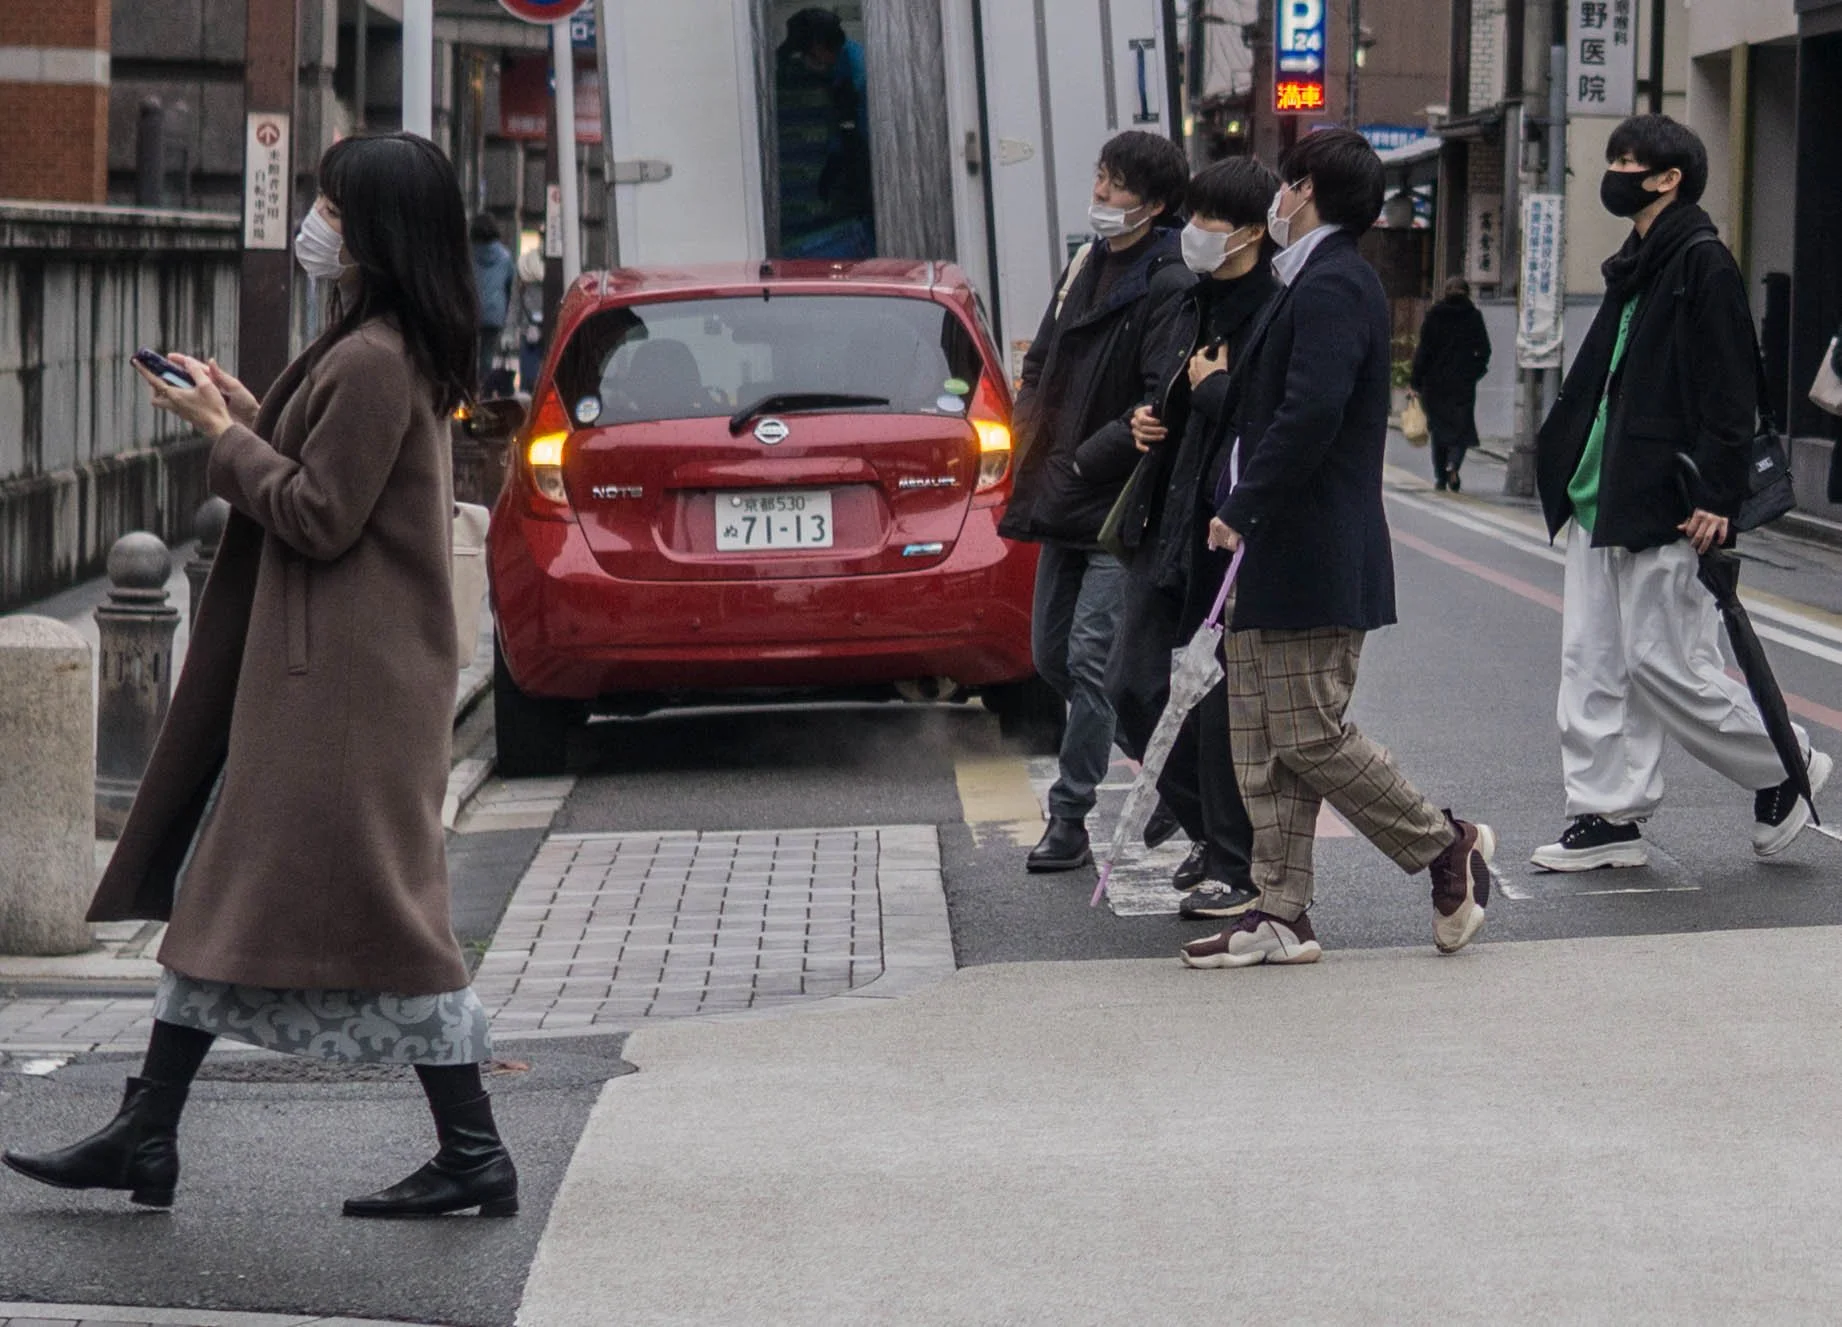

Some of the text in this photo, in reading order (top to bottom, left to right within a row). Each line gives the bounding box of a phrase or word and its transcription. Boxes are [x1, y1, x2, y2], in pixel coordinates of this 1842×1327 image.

[1579, 2, 1607, 102] 野医院
[1277, 82, 1324, 109] 満車
[741, 514, 826, 545] 71-13
